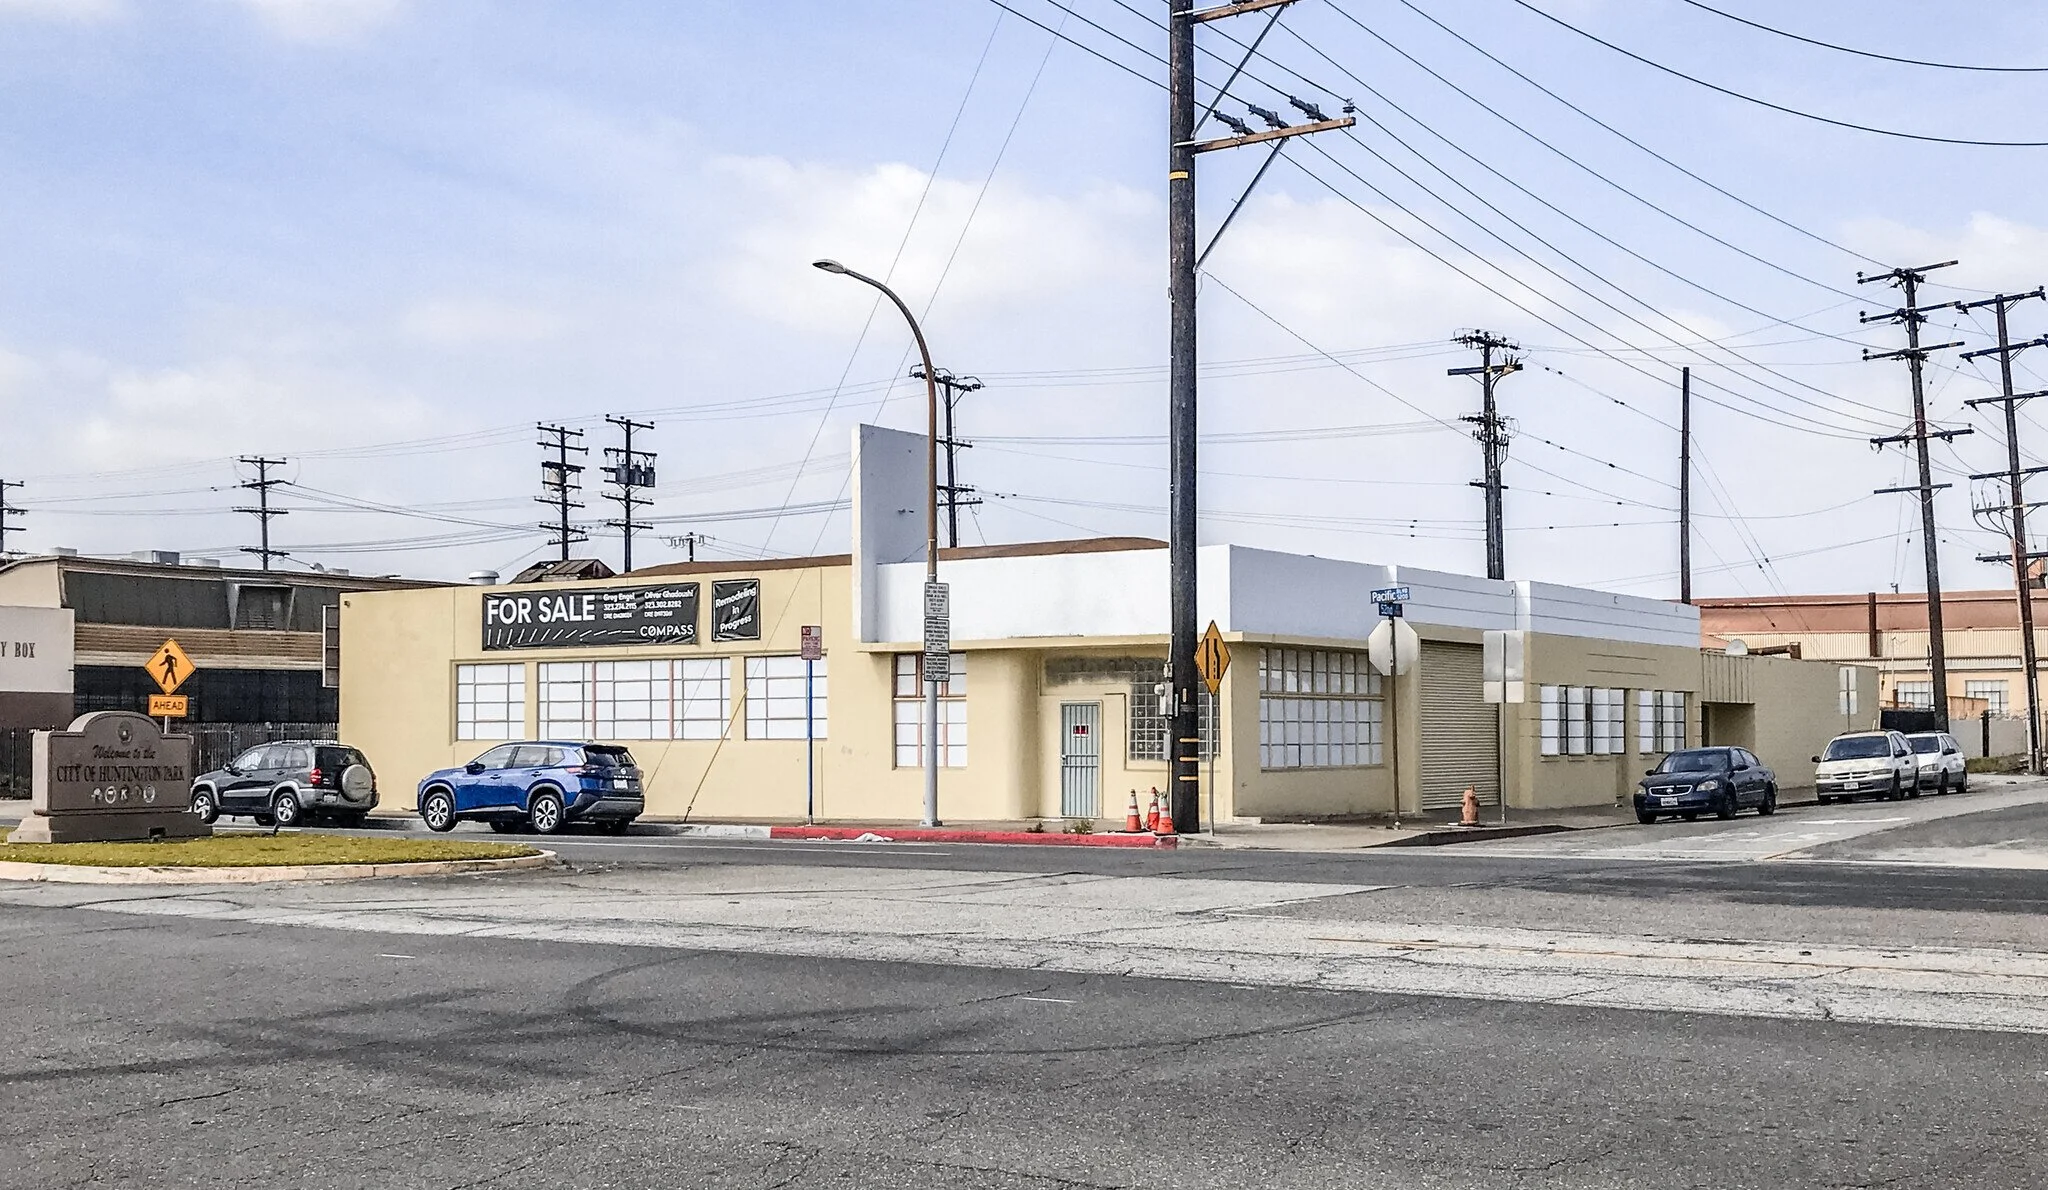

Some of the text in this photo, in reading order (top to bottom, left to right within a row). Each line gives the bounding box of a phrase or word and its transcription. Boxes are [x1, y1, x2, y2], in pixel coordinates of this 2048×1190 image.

[603, 592, 635, 602] Greg Engel
[644, 591, 661, 599] Oliver
[715, 587, 756, 608] Remodeling
[1372, 590, 1396, 602] Pacific
[487, 594, 596, 625] FOR SALE
[732, 605, 740, 615] in
[720, 614, 752, 632] Progress
[639, 624, 694, 637] COMPASS
[14, 642, 36, 658] BOX
[153, 701, 184, 711] AHEAD
[92, 745, 156, 759] Welcome to the
[56, 764, 185, 782] CITY OF HUNTINGTON PARK
